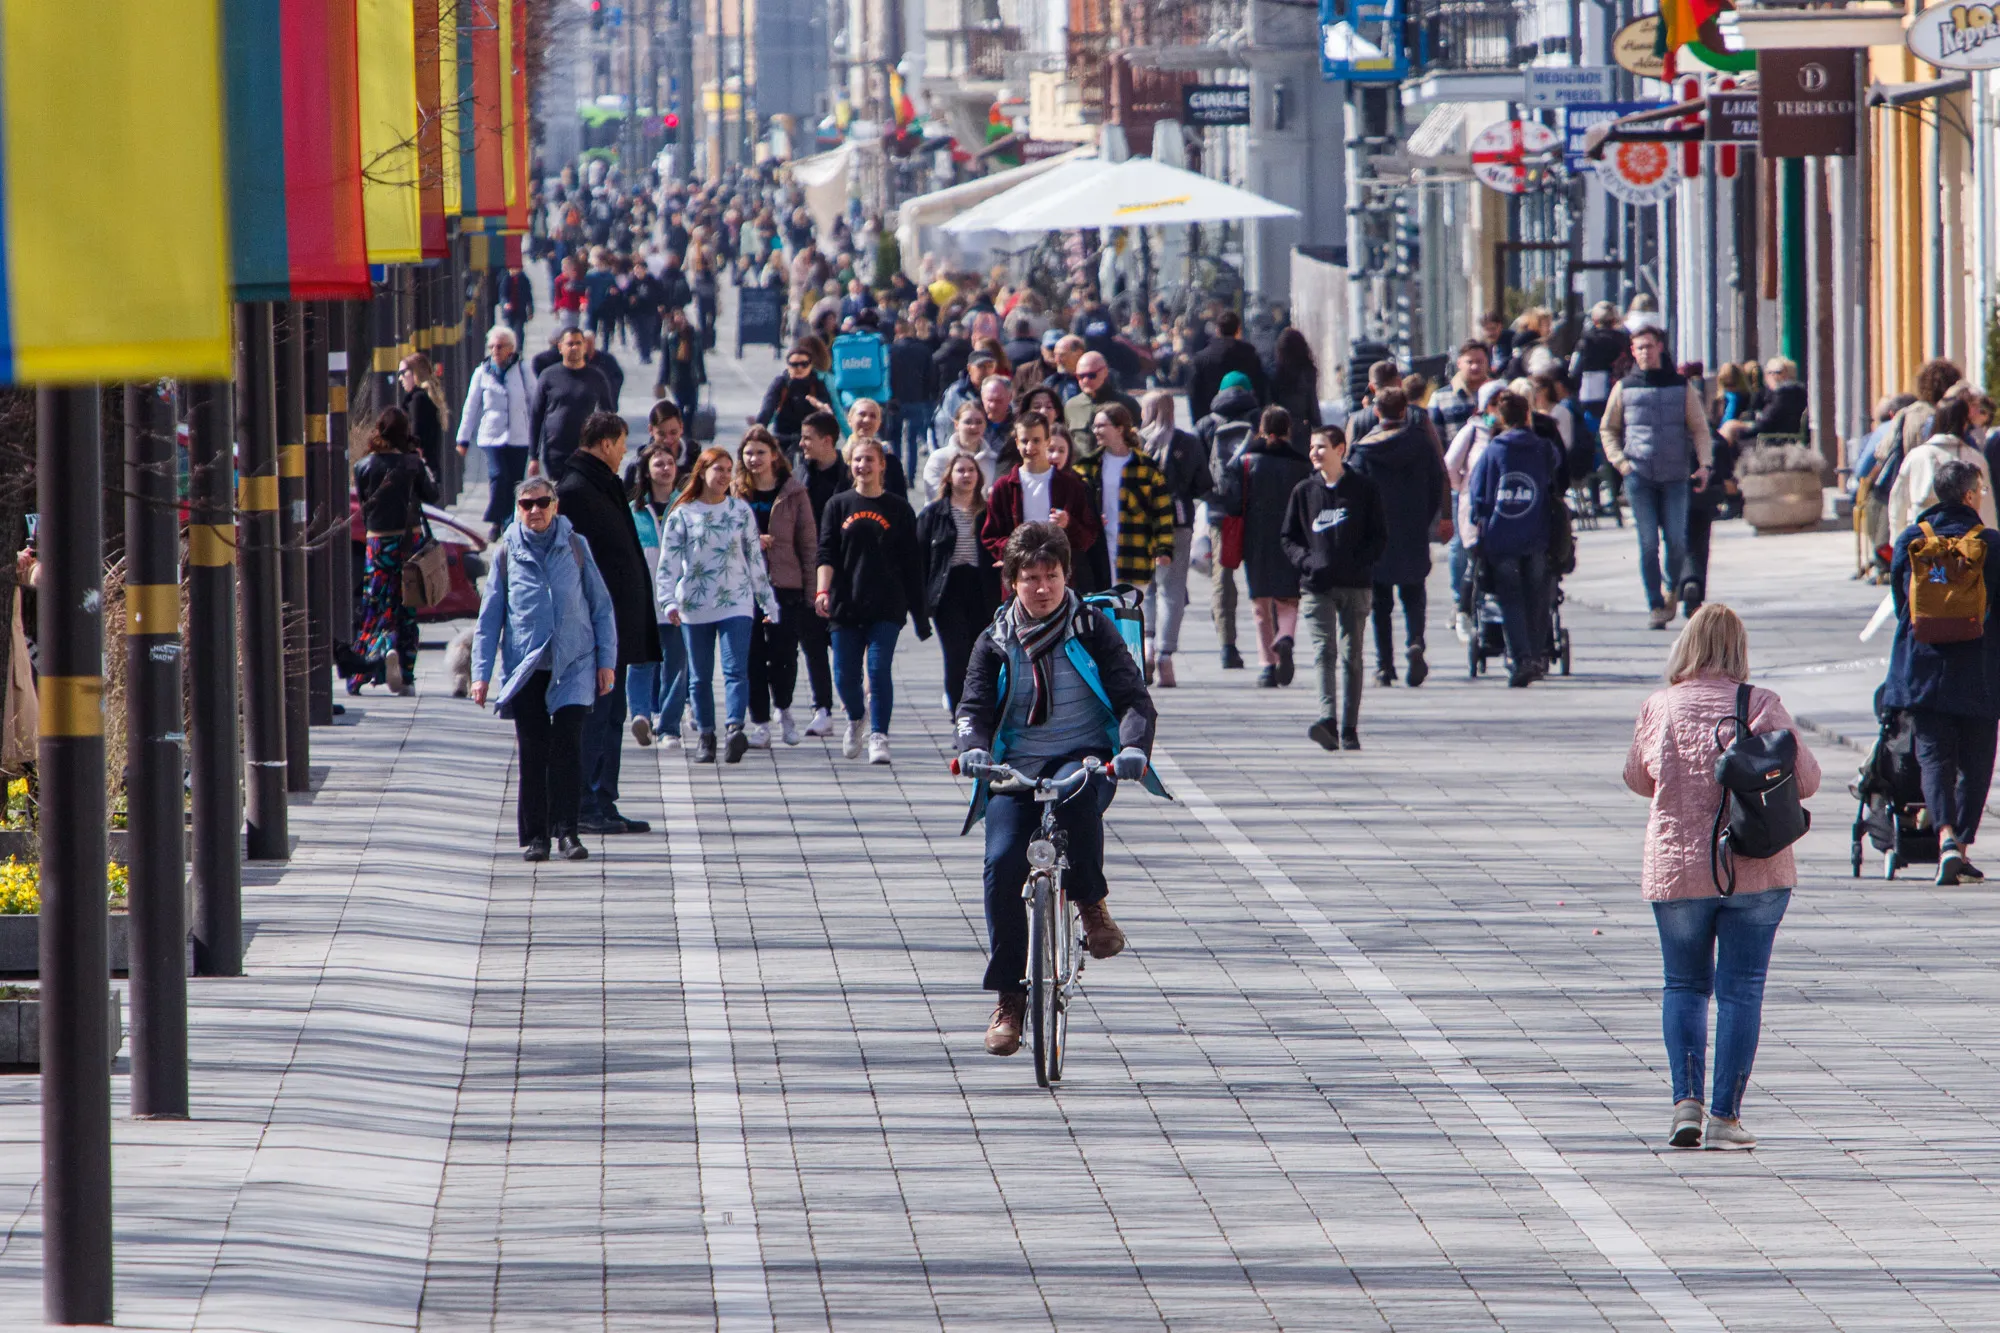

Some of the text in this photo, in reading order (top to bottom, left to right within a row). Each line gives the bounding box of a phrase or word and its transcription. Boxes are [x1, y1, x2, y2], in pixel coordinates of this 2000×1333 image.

[1189, 91, 1249, 108] CHARLIE
[1773, 100, 1854, 115] TERDECO
[842, 511, 890, 530] BEAUTIFUL
